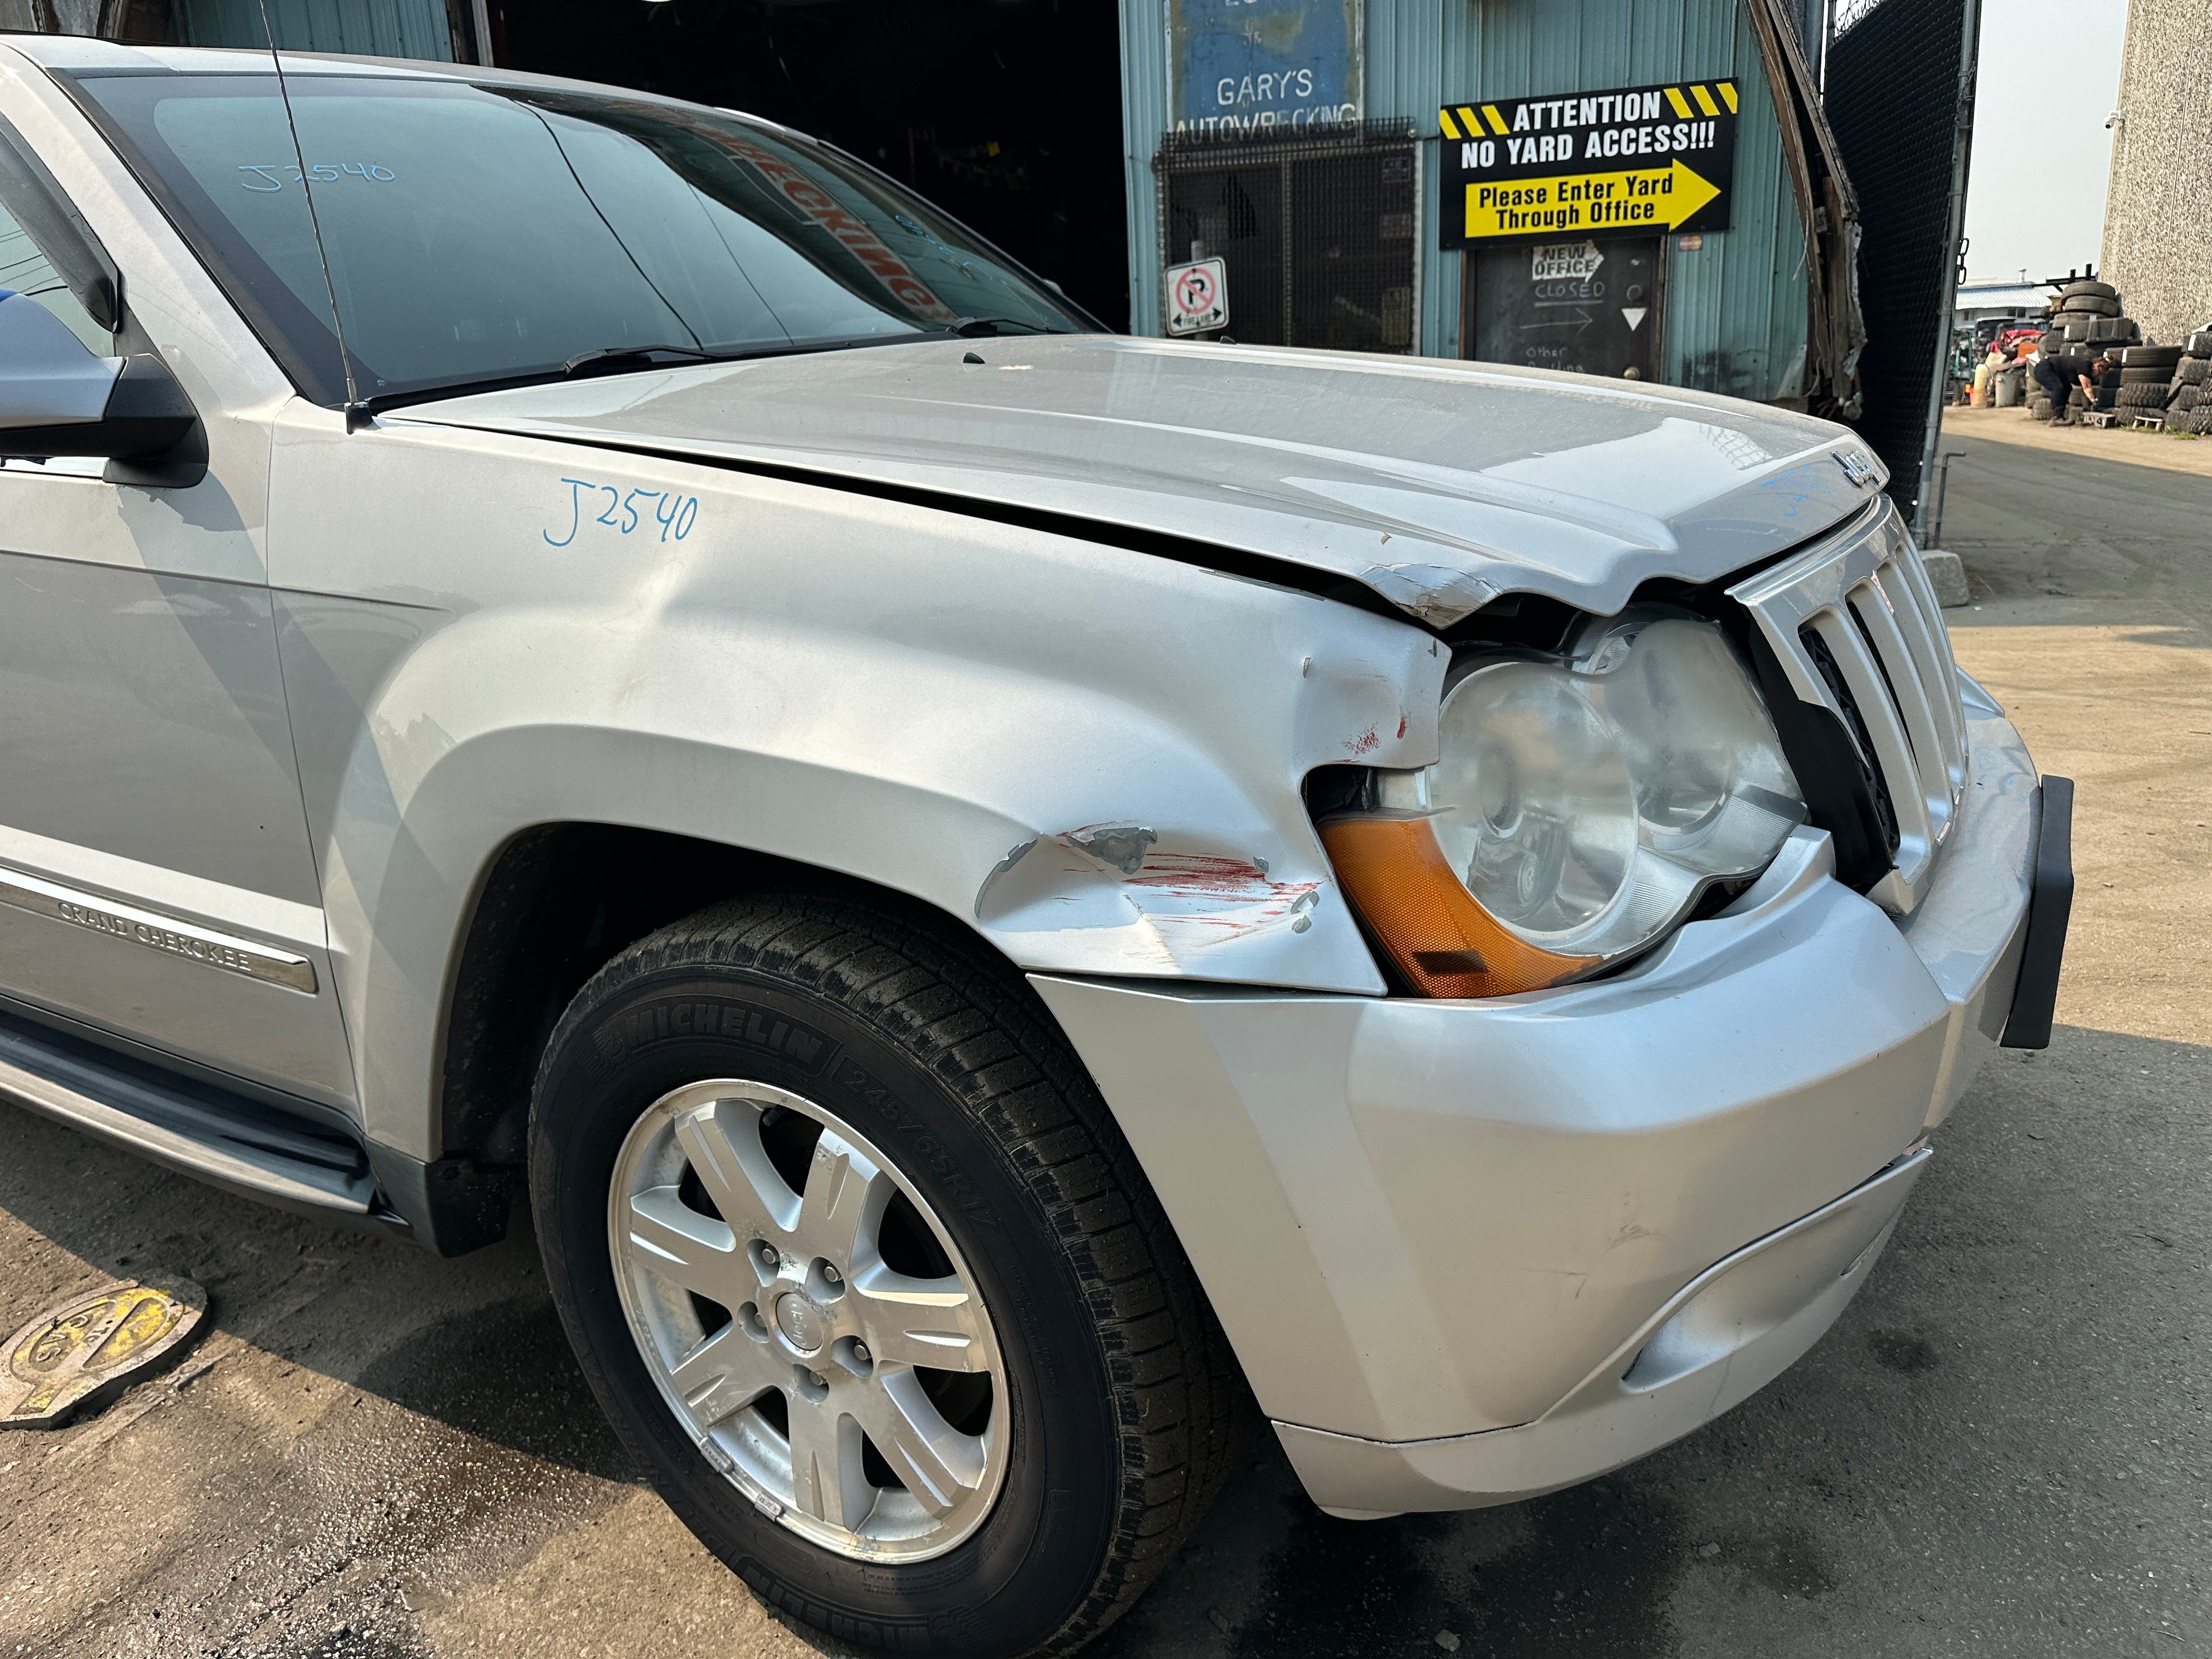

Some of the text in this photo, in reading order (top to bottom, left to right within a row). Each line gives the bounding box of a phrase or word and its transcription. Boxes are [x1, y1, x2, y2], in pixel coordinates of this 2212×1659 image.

[1217, 69, 1313, 105] GARY'S
[1513, 91, 1661, 132] ATTENTION
[1461, 120, 1715, 169] NO YARD ACCESS!!!
[238, 162, 396, 192] J2540
[1479, 173, 1672, 208] Please Enter Yard
[1496, 202, 1654, 229] Through Office
[1535, 260, 1595, 276] OFFICE
[1543, 246, 1584, 260] NEW
[1535, 281, 1605, 298] CLOSED
[1527, 346, 1567, 358] Other
[543, 478, 698, 547] J2540
[58, 902, 252, 971] GRAND CHEROKEE
[626, 1003, 823, 1065] MICHELIN
